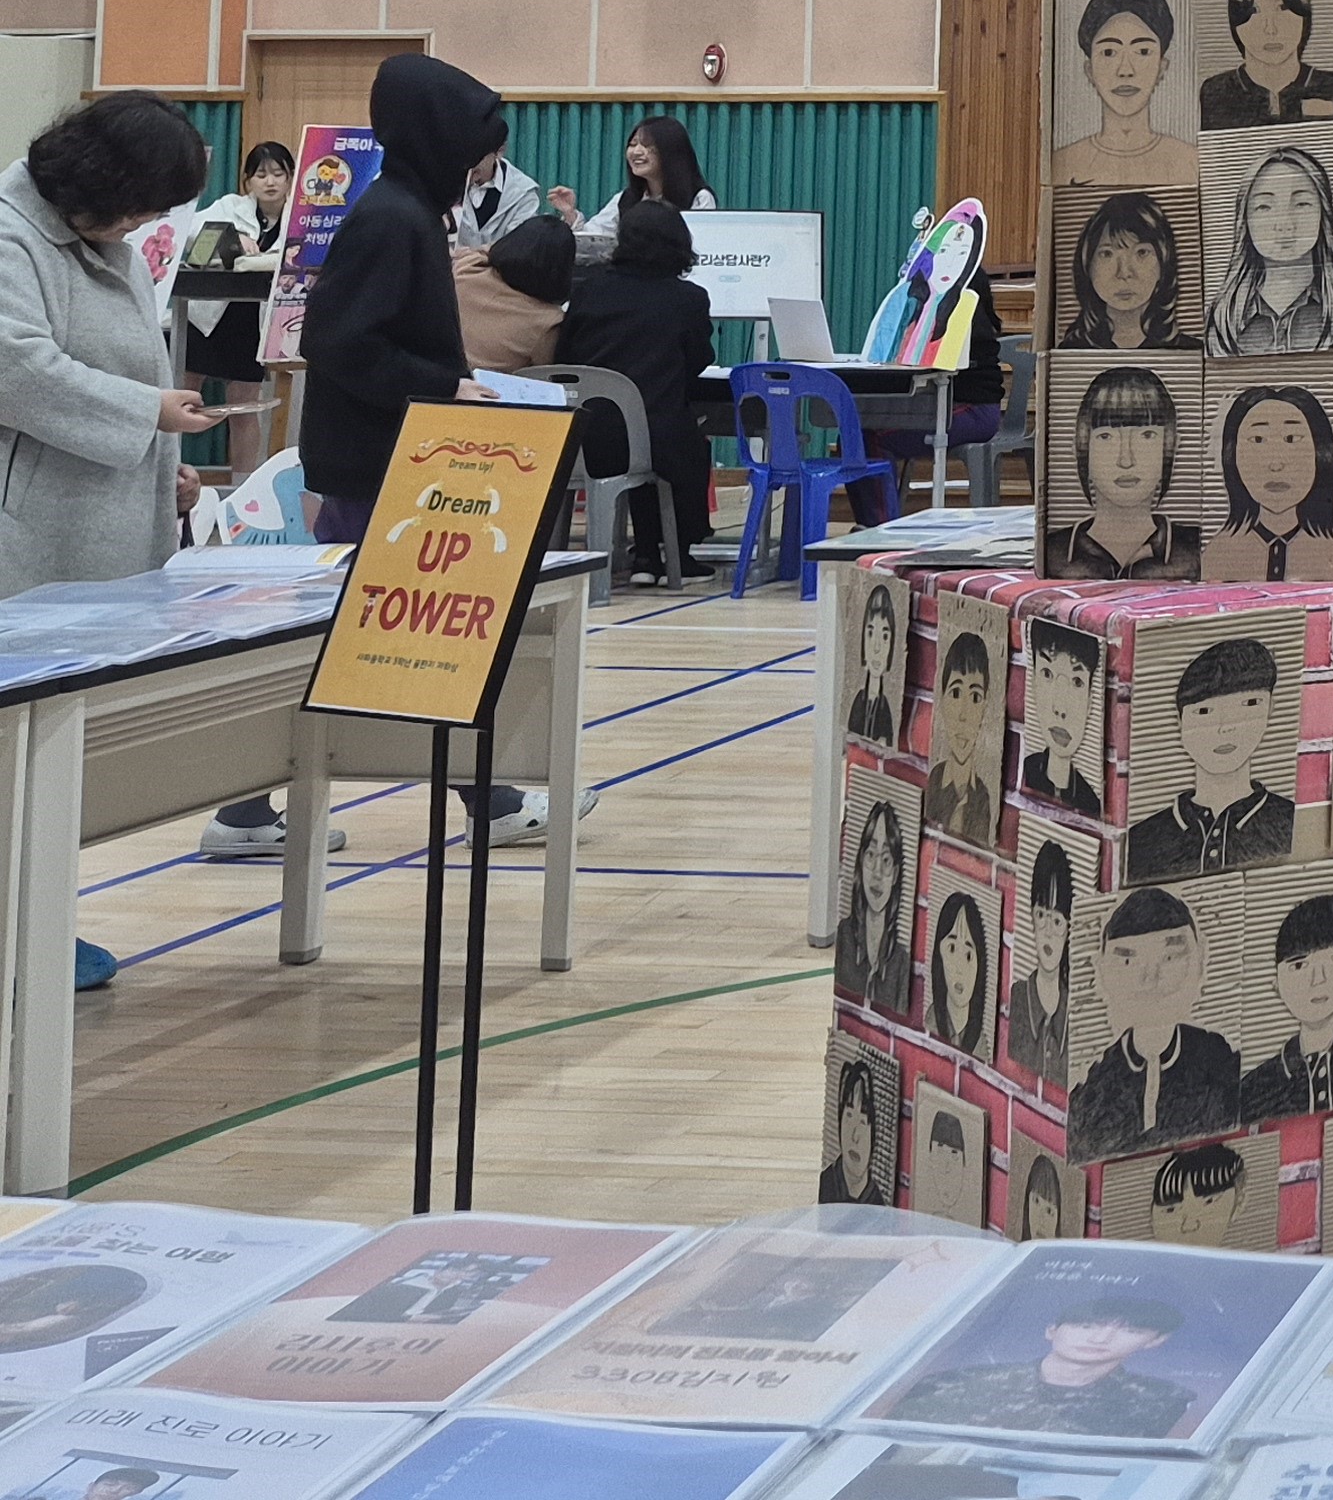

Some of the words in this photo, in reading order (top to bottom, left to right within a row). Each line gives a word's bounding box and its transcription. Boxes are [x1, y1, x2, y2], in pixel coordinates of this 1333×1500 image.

[448, 457, 472, 472] Dream
[473, 459, 495, 474] Up!
[426, 489, 493, 517] Dream
[416, 529, 472, 575] UP
[358, 582, 496, 641] TOWER
[164, 1247, 236, 1265] 여행
[66, 1407, 144, 1430] 미래
[145, 1414, 220, 1440] 진로
[224, 1426, 334, 1451] 이야기
